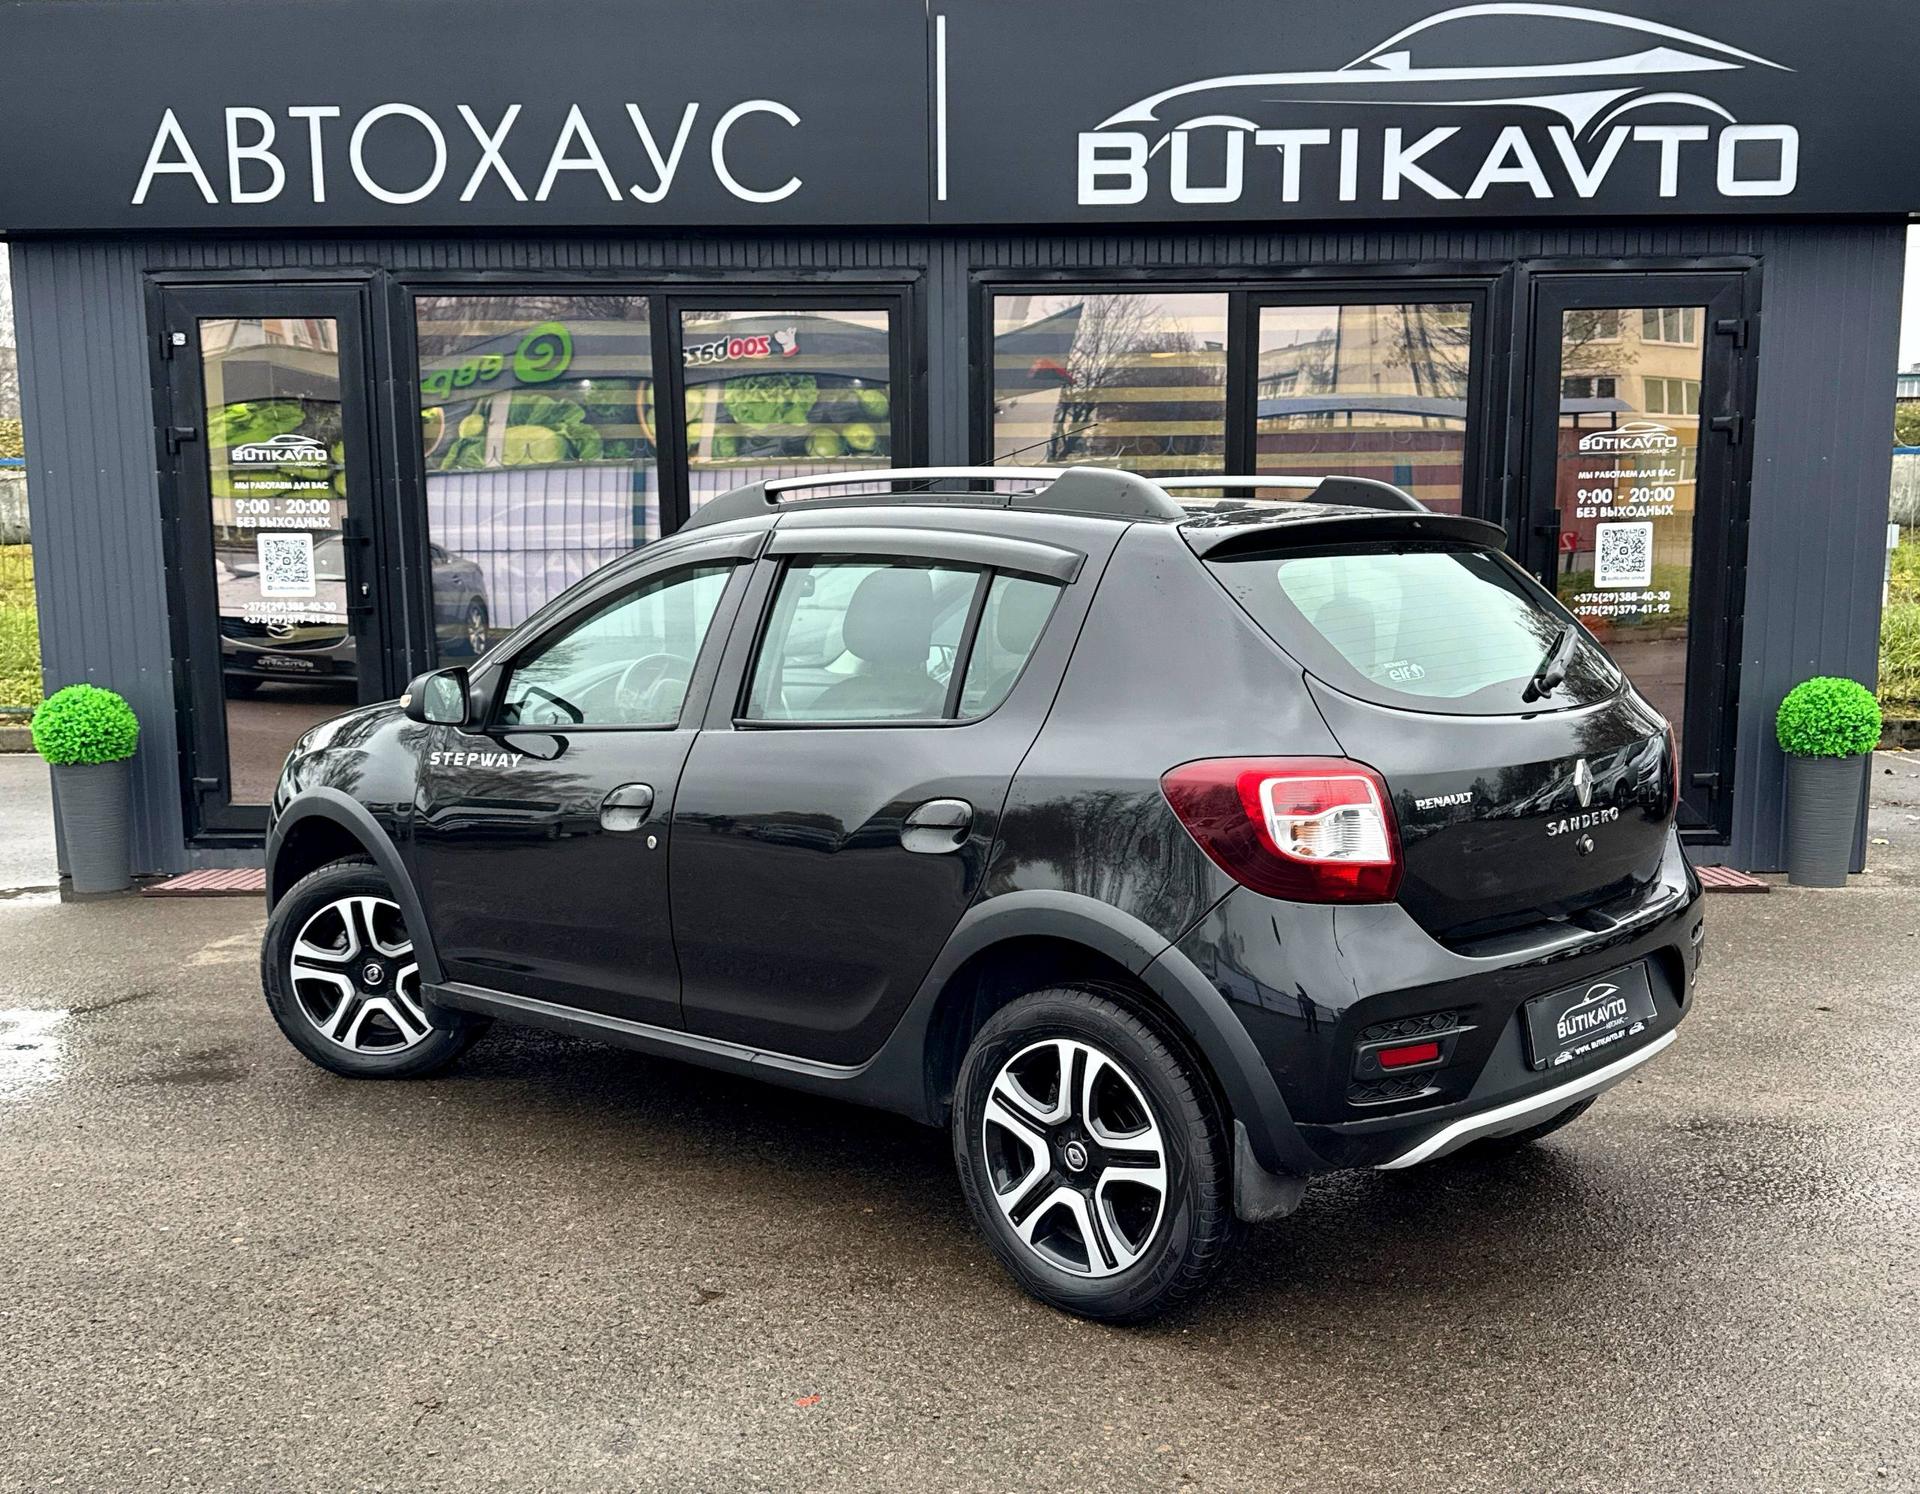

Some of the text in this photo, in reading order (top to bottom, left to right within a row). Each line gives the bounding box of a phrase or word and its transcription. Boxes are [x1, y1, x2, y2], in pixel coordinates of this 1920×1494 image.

[132, 100, 802, 204] АВТОХАУС
[1078, 124, 1799, 205] BUTIKAVTO
[1579, 436, 1677, 450] BUTIKAVTO
[232, 449, 328, 462] BUTIKAVTO
[1578, 469, 1676, 479] МЫ РАБОТАЕМ ДЛЯ ВАС
[1577, 489, 1613, 504] 9:00
[1629, 487, 1675, 503] 20:00
[235, 500, 270, 514] 9:00
[286, 499, 330, 514] 20:00
[1576, 505, 1674, 518] БЕЗ ВЫХОДНЫХ
[236, 517, 331, 528] БЕЗ ВЫХОДНЫХ
[1572, 604, 1670, 617] +375(29)379-41-92
[1389, 666, 1411, 680] elf
[430, 752, 523, 768] STEPWAY
[1415, 792, 1474, 811] RENAULT
[1546, 807, 1619, 836] SANDERO
[1557, 998, 1627, 1039] BUTIKAVTO
